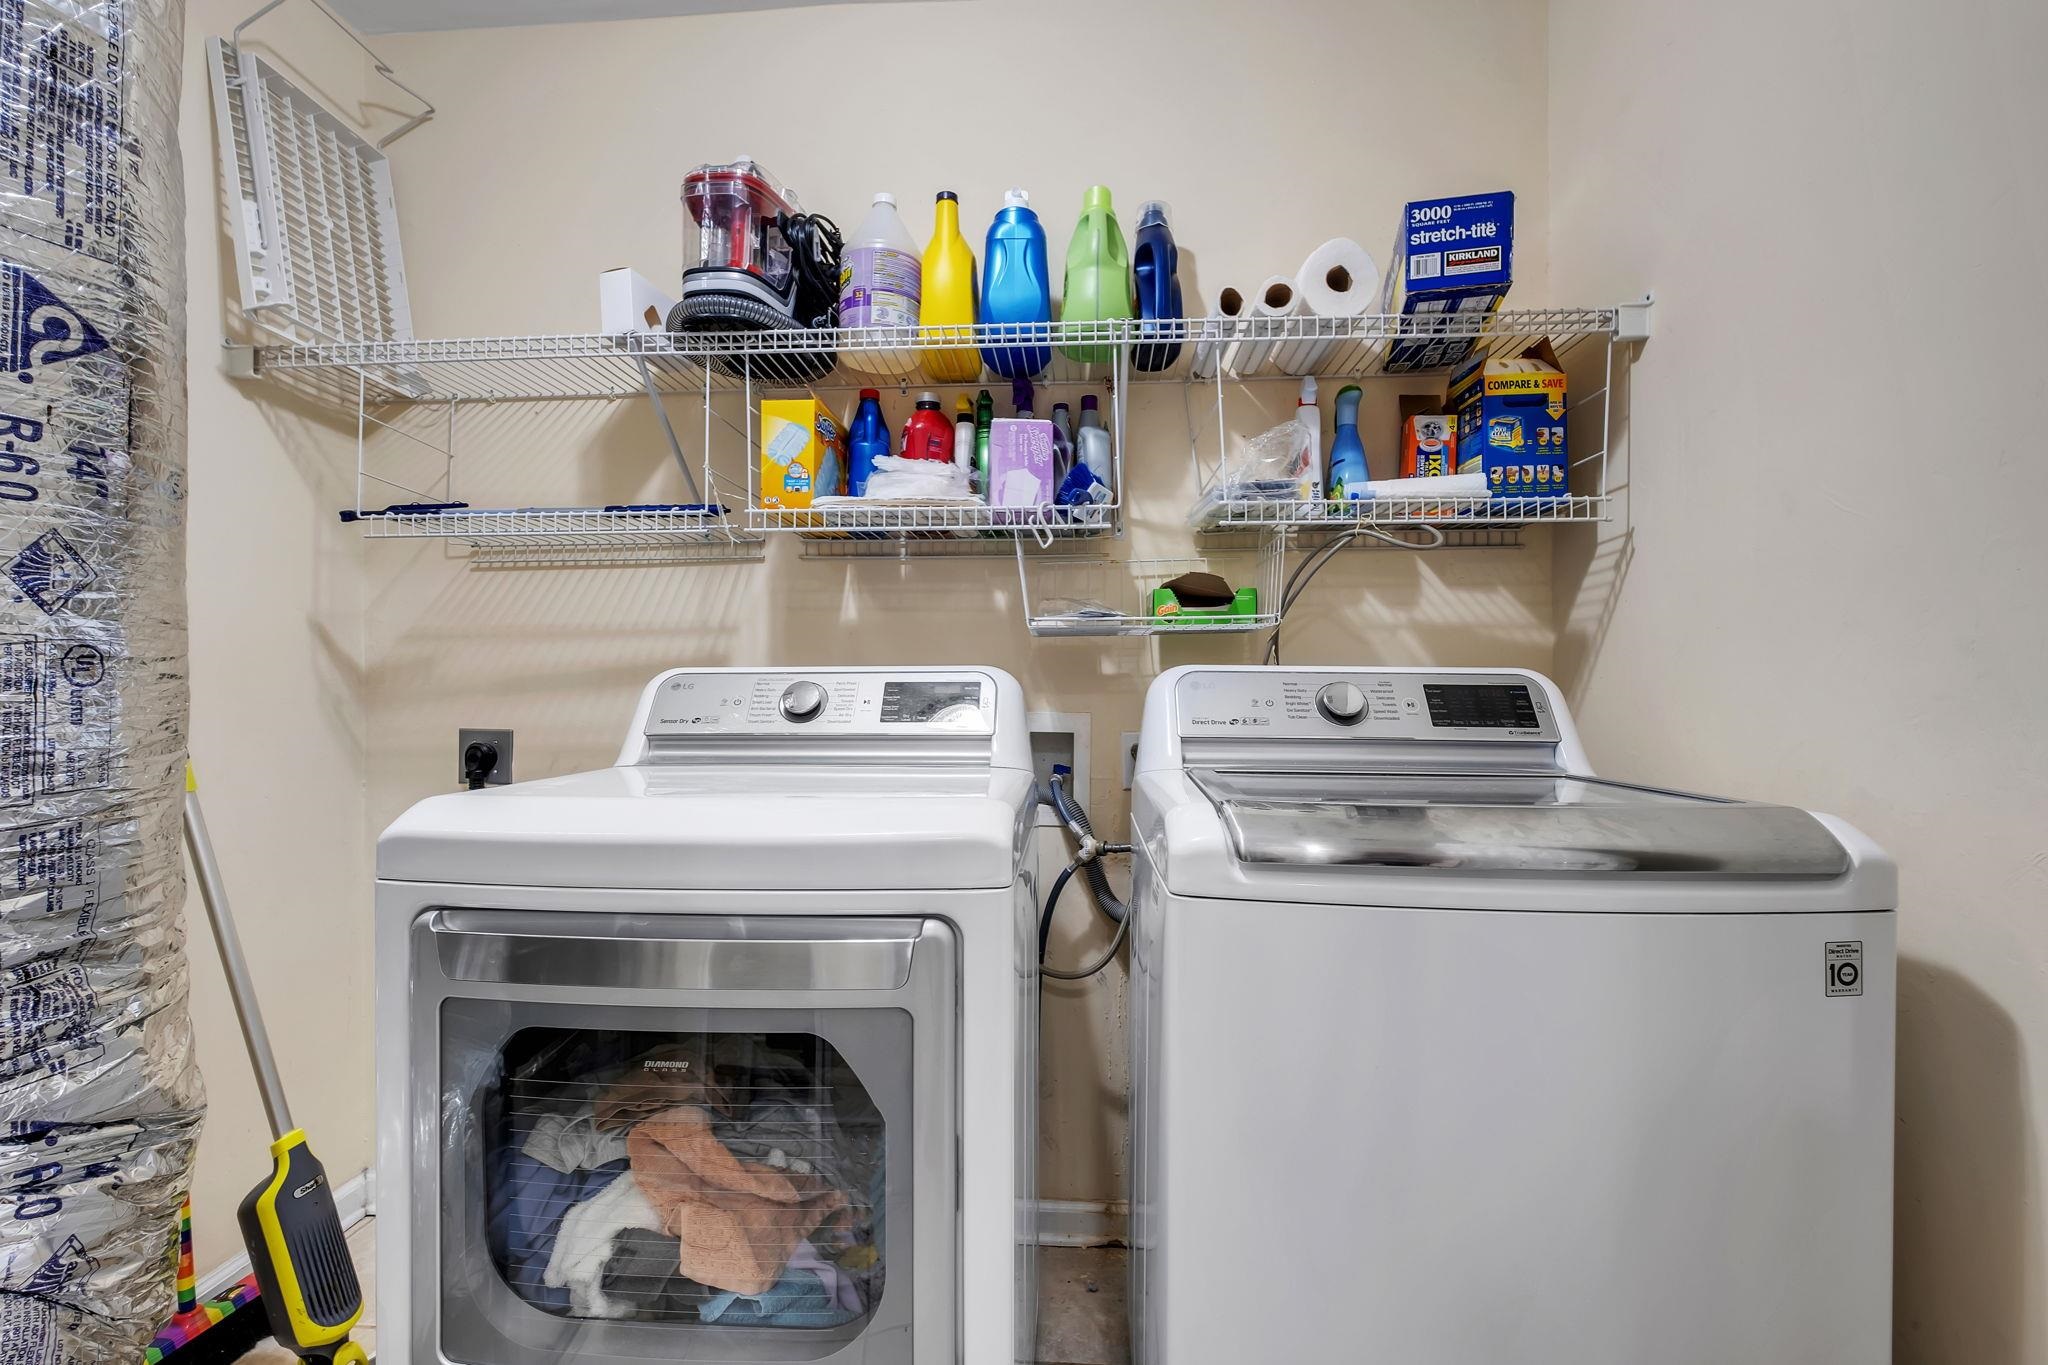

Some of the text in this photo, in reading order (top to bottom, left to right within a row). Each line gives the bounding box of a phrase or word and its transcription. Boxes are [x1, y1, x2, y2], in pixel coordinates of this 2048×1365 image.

[106, 53, 118, 87] DUCT
[106, 90, 118, 118] (FOR
[26, 136, 34, 150] FOR
[24, 150, 34, 196] INSTALLATION
[105, 173, 117, 197] USE
[104, 200, 116, 237] ONLY)
[1410, 205, 1452, 223] 3000
[1410, 222, 1496, 245] stretch-tite
[1448, 249, 1498, 261] KIRKLAND
[1488, 378, 1564, 390] COMPARE & SAVE
[1026, 425, 1044, 467] Sweeper
[1429, 454, 1441, 476] OXI
[1156, 604, 1179, 616] Gain
[2, 643, 12, 693] PERFORMANC
[70, 653, 97, 678] UL
[70, 689, 84, 726] LISTED
[85, 839, 96, 876] CLASS
[76, 890, 94, 937] FLEXIBLE
[69, 967, 88, 991] (FO
[1830, 962, 1858, 986] 10
[42, 993, 51, 1020] PRODUC
[16, 1310, 31, 1362] INSTALLATION
